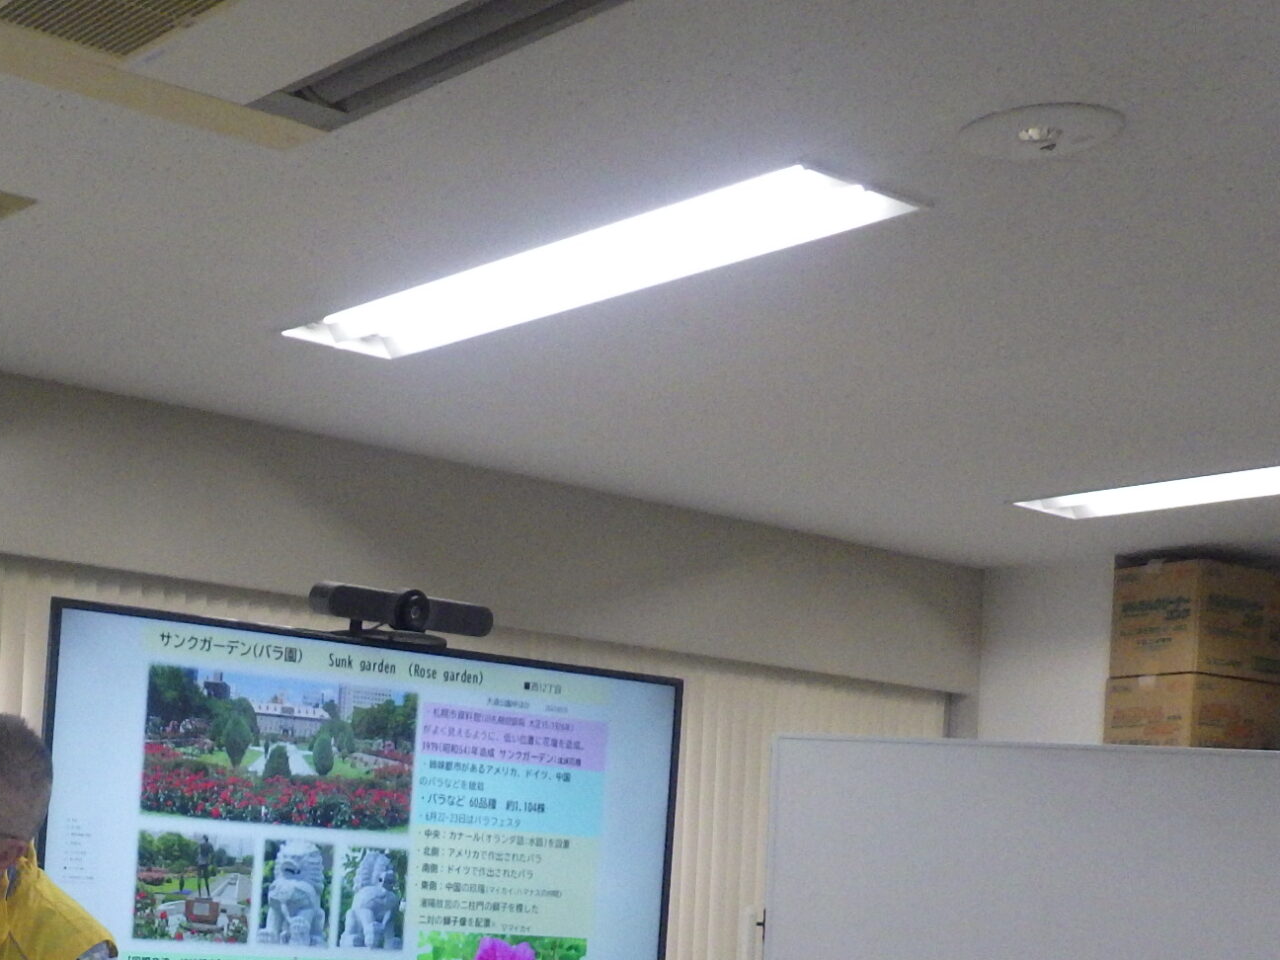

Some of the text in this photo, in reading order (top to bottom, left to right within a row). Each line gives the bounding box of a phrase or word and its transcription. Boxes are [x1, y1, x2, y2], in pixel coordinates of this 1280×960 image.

[328, 653, 353, 670] Sunk
[359, 658, 396, 675] garden
[408, 662, 438, 681] (Rose
[442, 667, 484, 686] garden)
